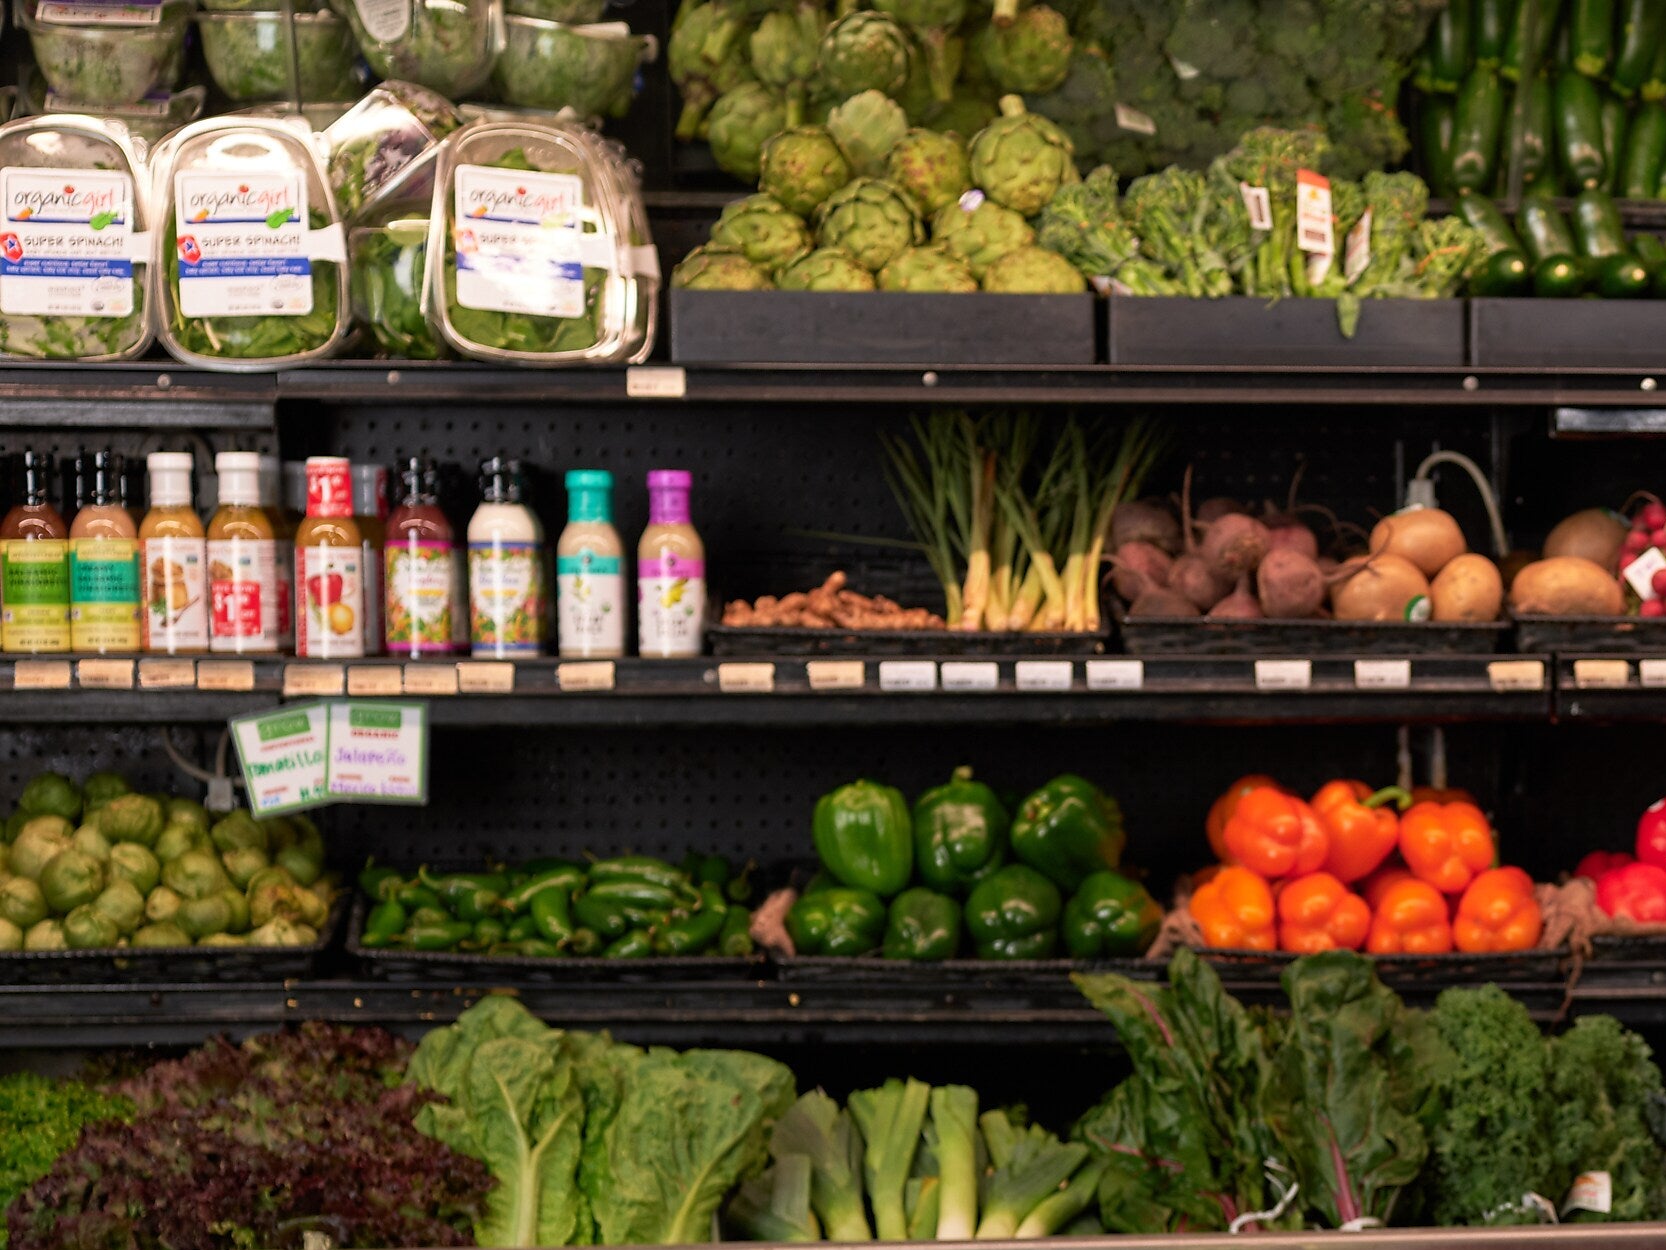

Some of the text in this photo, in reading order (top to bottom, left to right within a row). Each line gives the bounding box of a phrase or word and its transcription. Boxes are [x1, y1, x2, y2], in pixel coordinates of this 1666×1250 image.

[14, 186, 114, 215] organicgirl
[190, 184, 289, 215] organicgirl
[24, 235, 63, 248] SUPER
